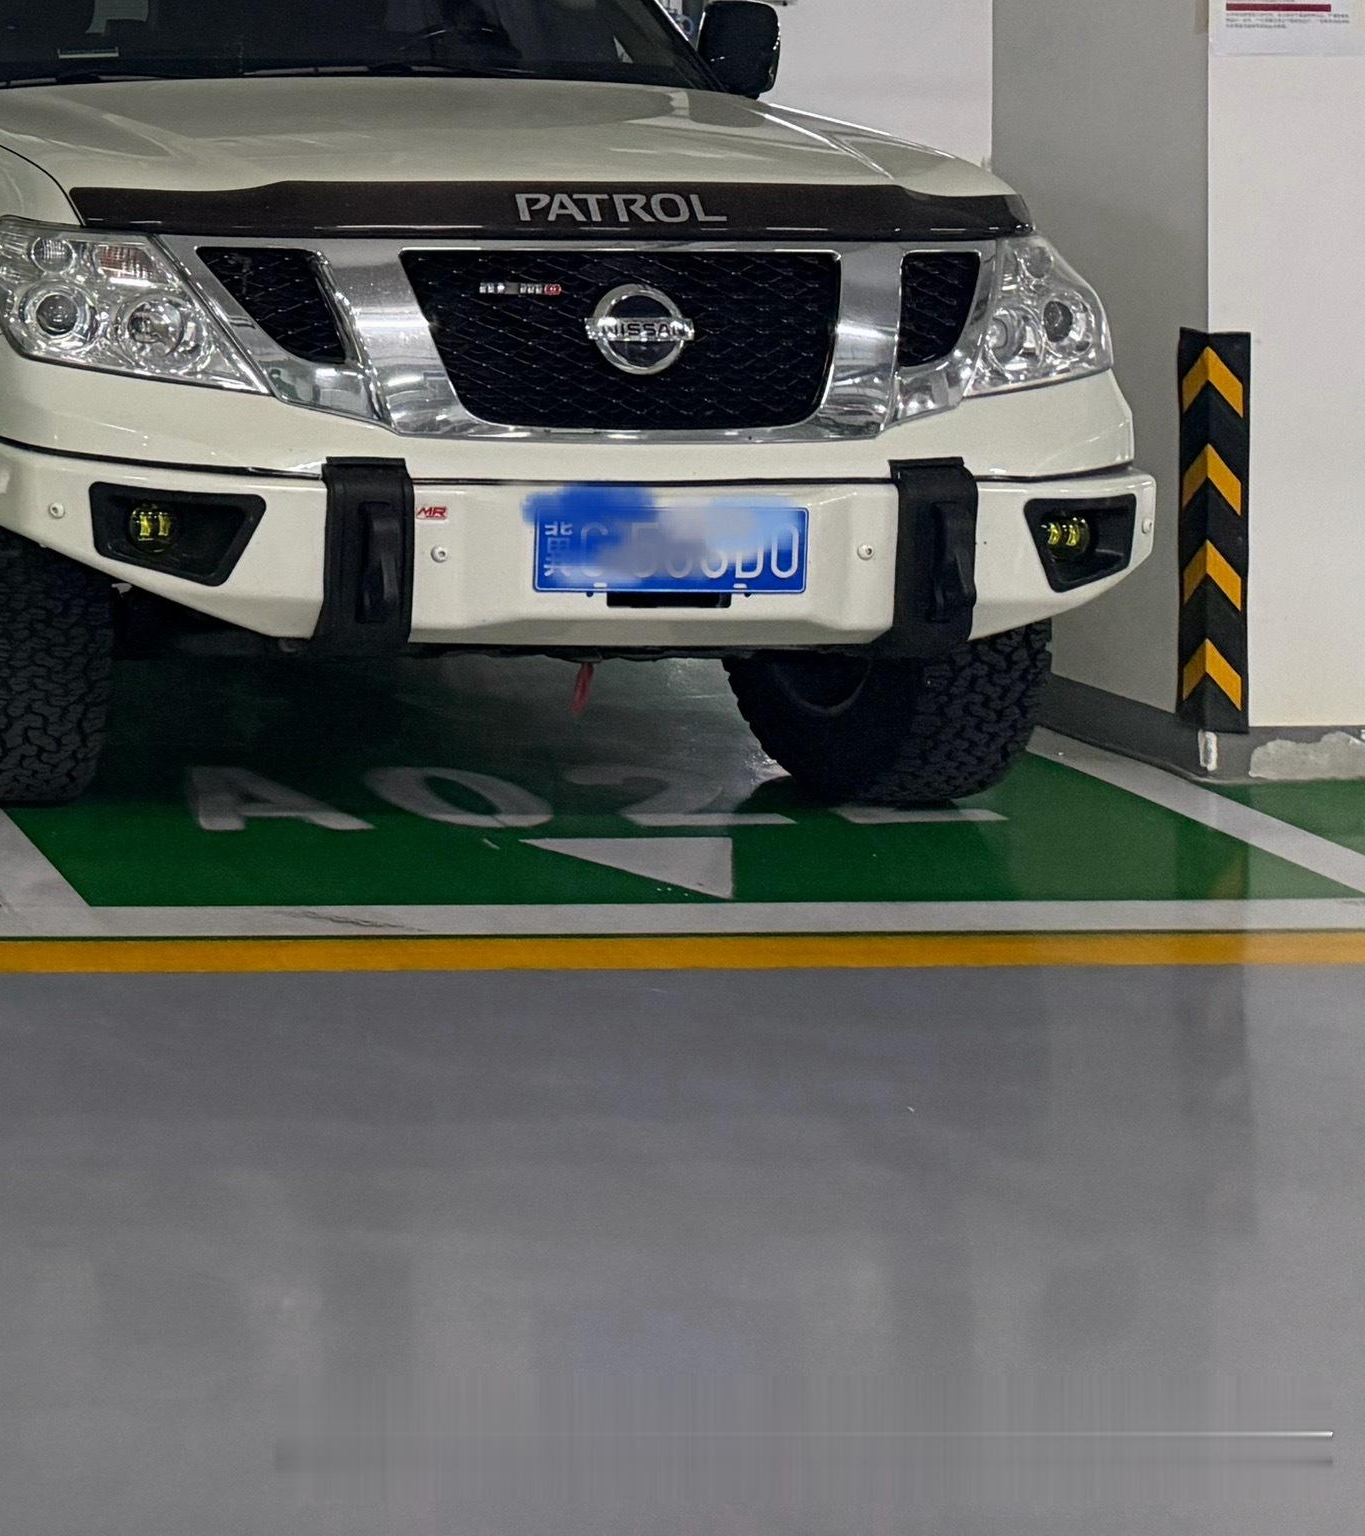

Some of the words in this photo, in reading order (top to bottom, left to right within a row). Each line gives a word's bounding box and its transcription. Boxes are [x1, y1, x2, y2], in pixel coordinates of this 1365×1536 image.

[515, 193, 728, 223] PATROL
[601, 322, 687, 337] NISSAN
[184, 765, 1009, 831] A02
